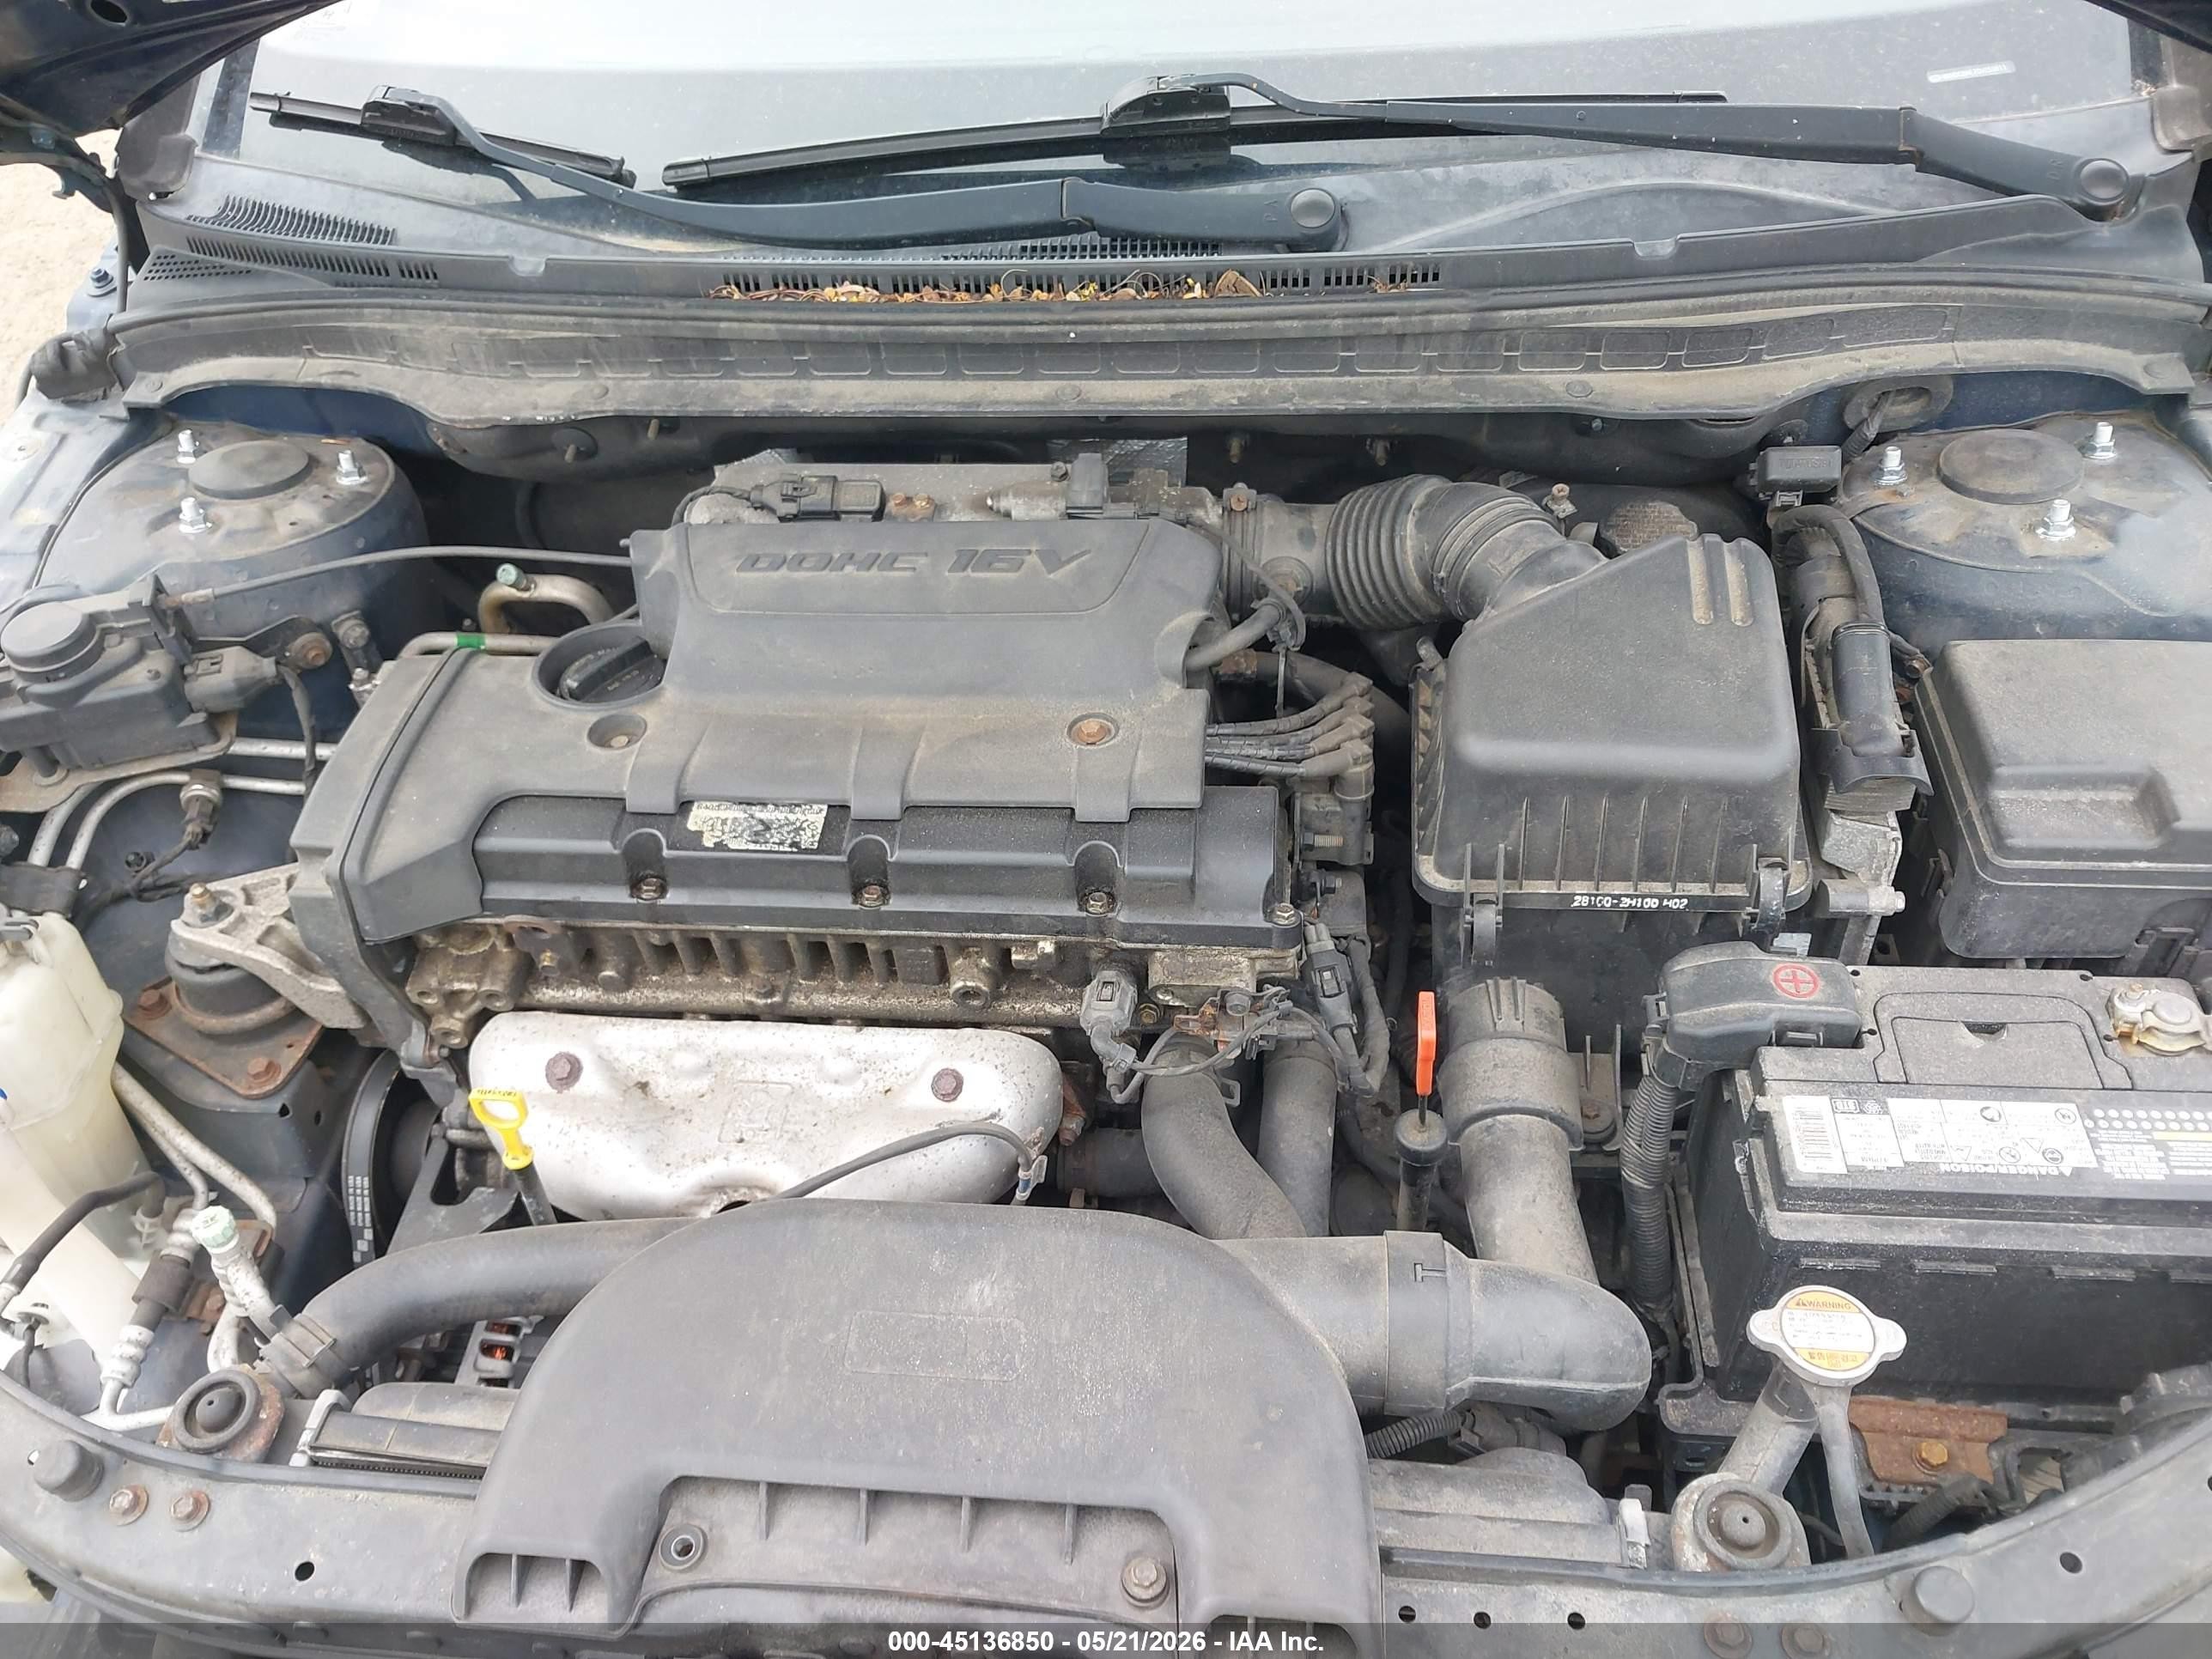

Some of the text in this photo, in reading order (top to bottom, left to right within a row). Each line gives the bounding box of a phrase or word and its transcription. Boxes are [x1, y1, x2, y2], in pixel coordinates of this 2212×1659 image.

[735, 548, 1092, 576] DOHC 16V
[1806, 1299, 1851, 1310] WARNING
